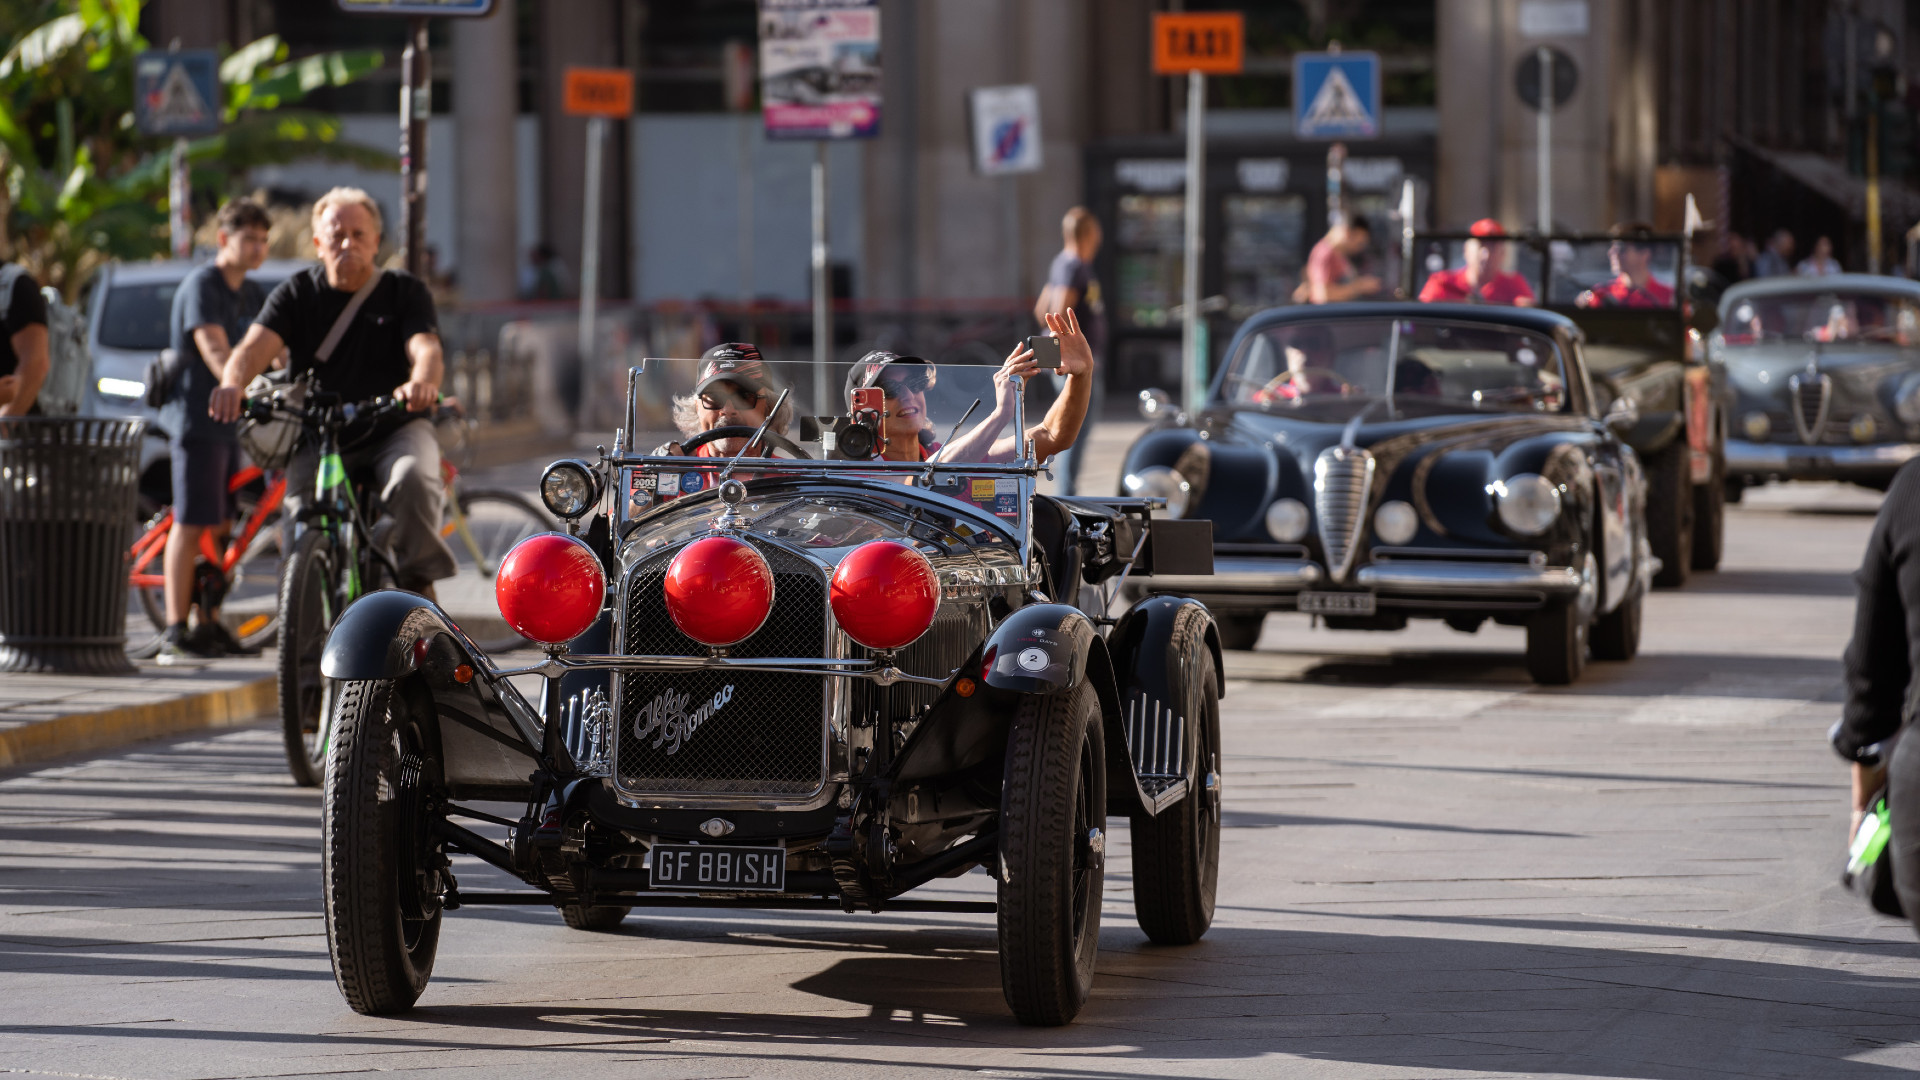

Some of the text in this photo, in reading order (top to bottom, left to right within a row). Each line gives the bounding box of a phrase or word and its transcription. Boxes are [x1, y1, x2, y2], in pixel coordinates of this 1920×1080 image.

[1166, 26, 1233, 57] TAXI
[632, 478, 657, 487] 2003
[1039, 638, 1059, 647] DAYS
[1029, 653, 1039, 663] 2
[633, 687, 691, 750] Alfa
[662, 684, 735, 756] Romeo
[658, 851, 692, 881] GF
